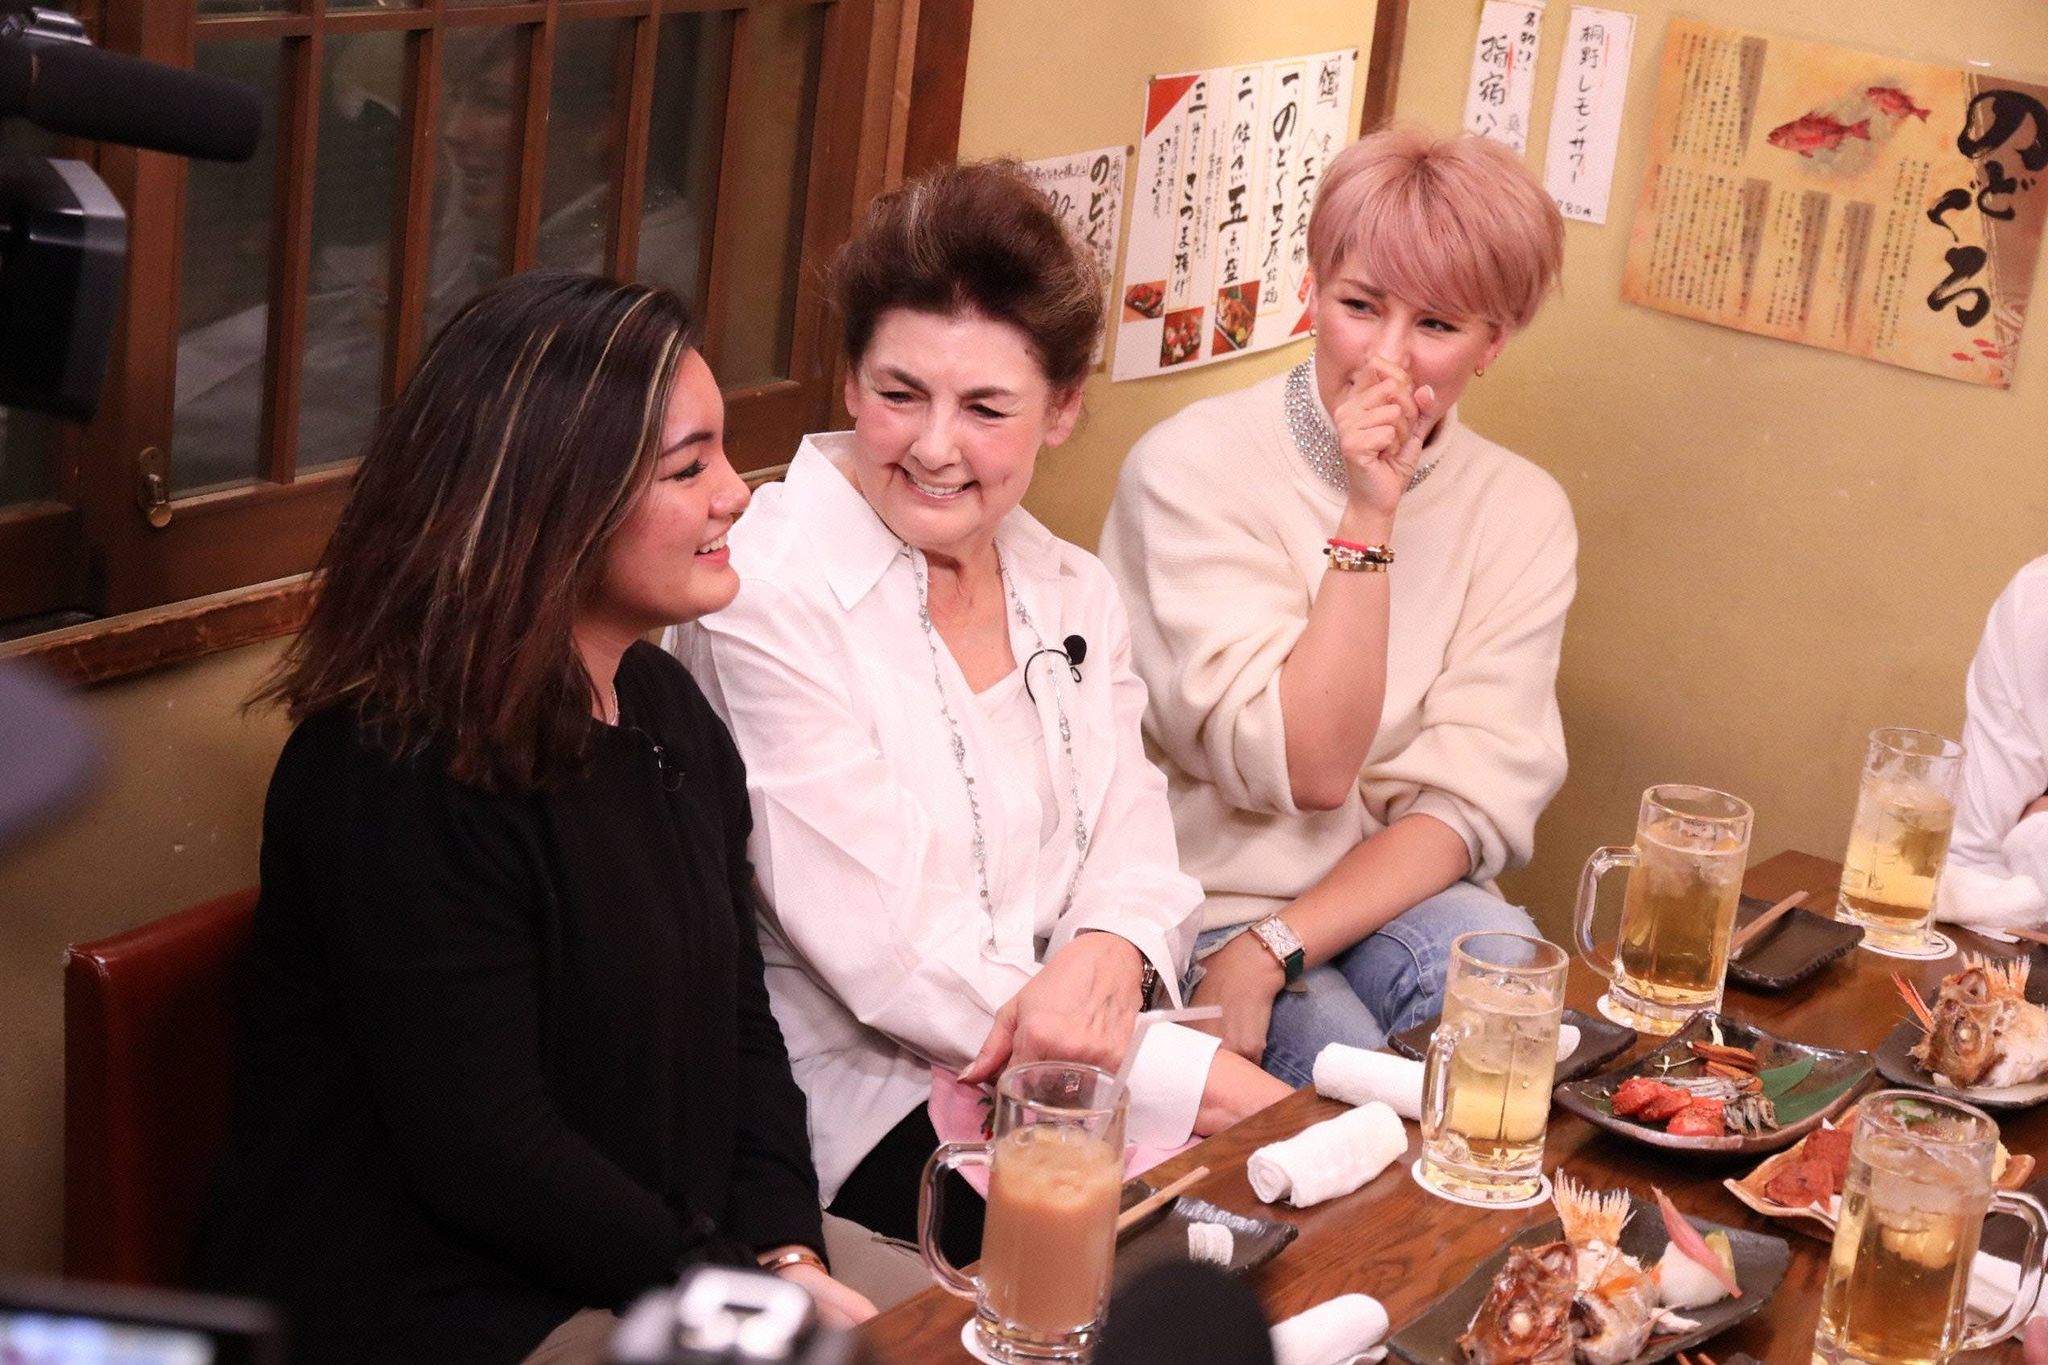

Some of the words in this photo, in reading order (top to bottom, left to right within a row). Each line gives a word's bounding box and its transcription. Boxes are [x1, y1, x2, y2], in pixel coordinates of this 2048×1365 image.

[1475, 34, 1508, 137] 指宿ハ
[1926, 89, 2048, 328] のどぐろ
